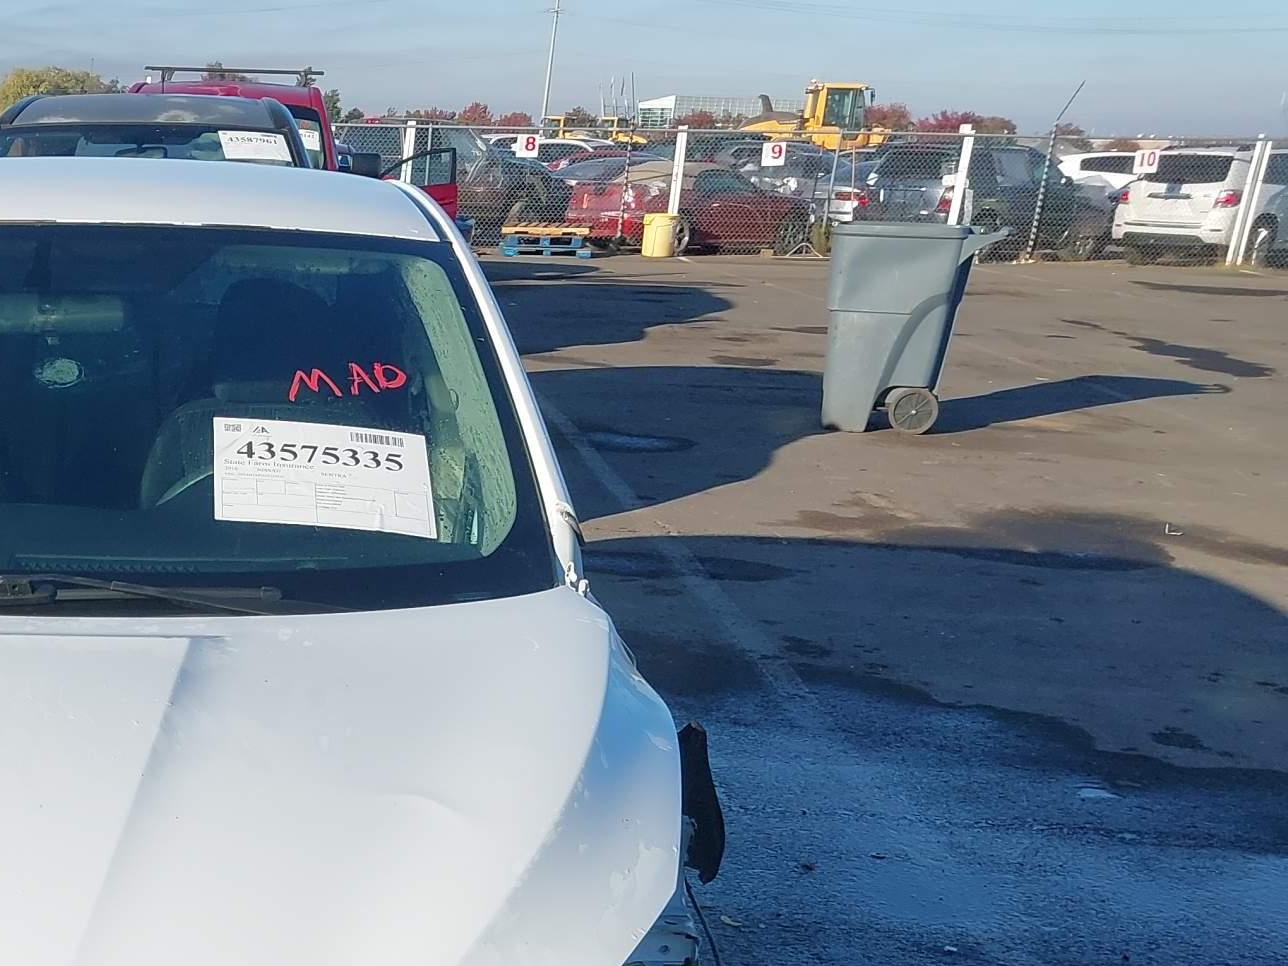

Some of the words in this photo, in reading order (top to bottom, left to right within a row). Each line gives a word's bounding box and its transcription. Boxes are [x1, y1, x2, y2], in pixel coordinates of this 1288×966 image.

[525, 136, 536, 151] 8
[771, 144, 782, 159] 9
[1139, 152, 1156, 167] 10
[237, 441, 403, 472] 43575335
